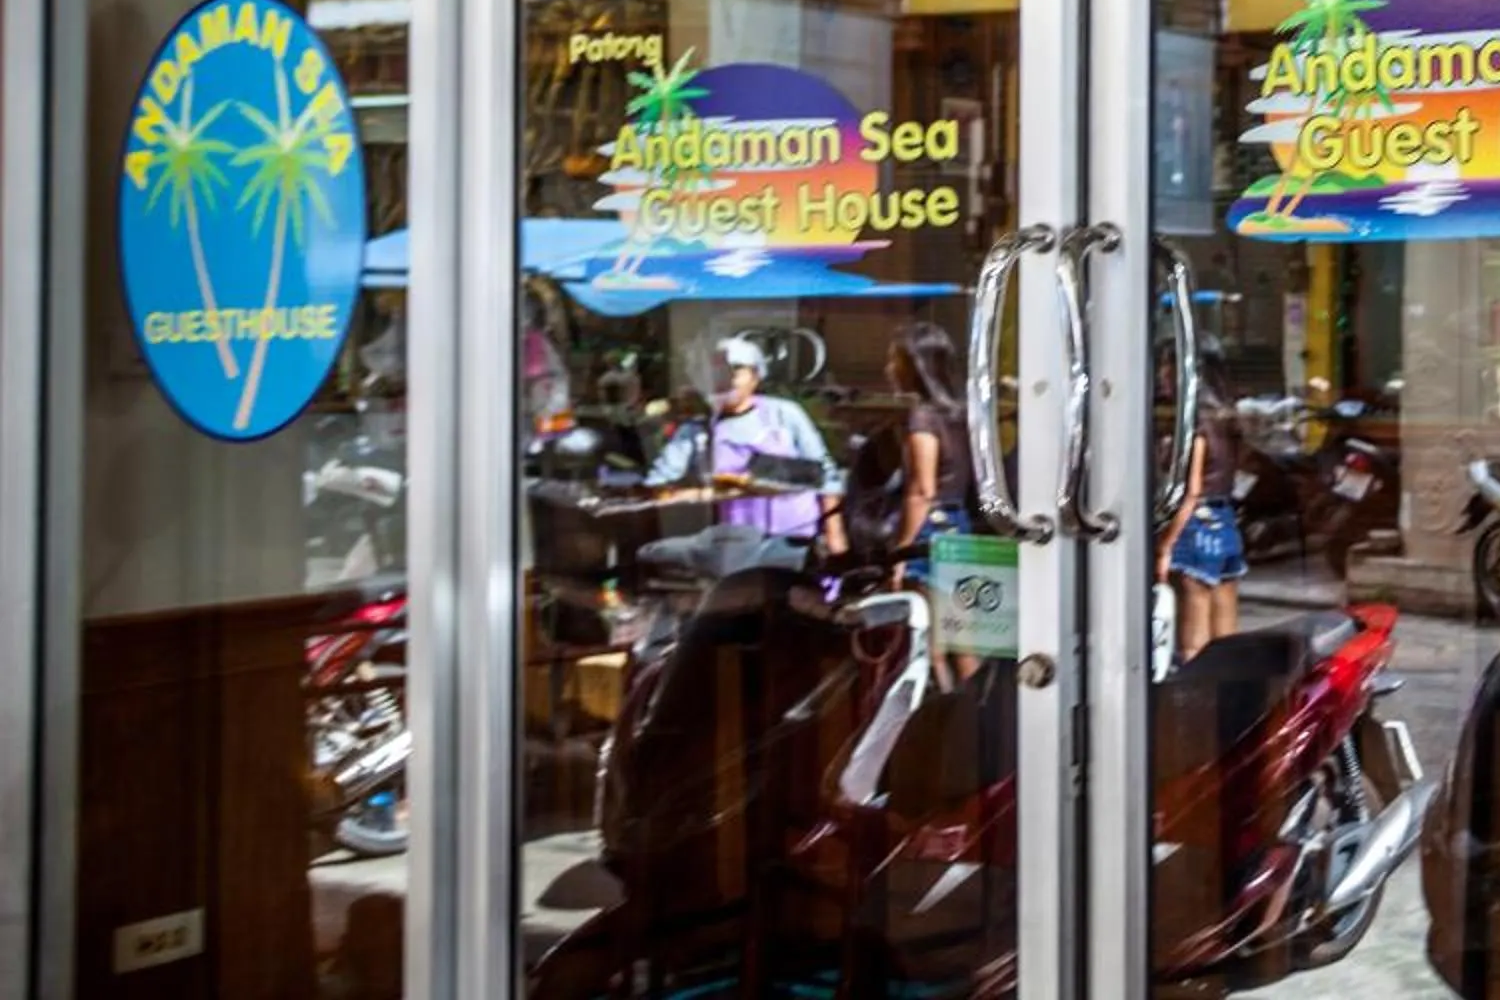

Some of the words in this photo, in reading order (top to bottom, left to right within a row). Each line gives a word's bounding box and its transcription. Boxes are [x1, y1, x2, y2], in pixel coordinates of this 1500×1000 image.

[570, 33, 662, 66] Patong
[126, 4, 291, 188] ANDAMAN
[610, 117, 841, 171] Andaman
[858, 110, 960, 164] Sea
[1299, 107, 1480, 171] Guest
[640, 187, 781, 236] Guest
[799, 182, 960, 232] House
[145, 306, 338, 343] GUESTHOUSE
